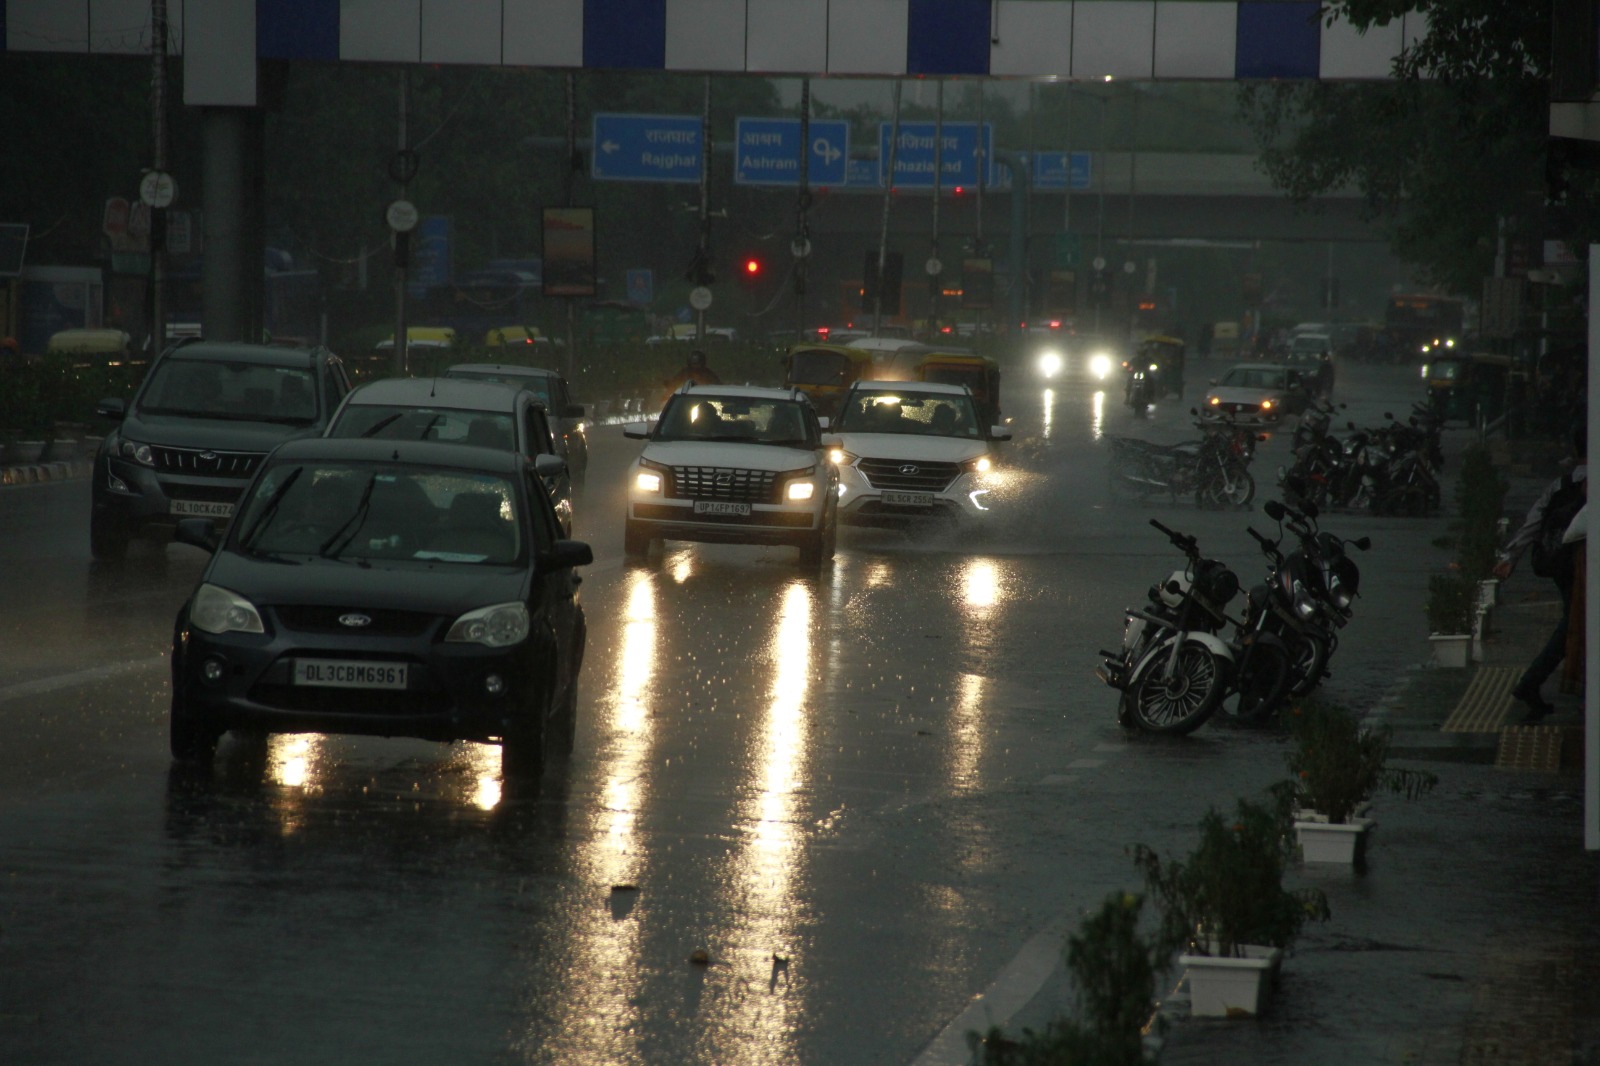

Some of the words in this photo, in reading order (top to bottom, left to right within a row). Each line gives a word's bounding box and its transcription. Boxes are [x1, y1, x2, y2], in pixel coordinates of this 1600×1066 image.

[645, 129, 696, 145] राजघाट
[743, 131, 782, 147] आश्रम
[642, 152, 696, 169] Rajghat
[743, 155, 797, 170] Ashram
[891, 160, 962, 173] haziaad
[306, 664, 405, 685] DL3CBM6961
